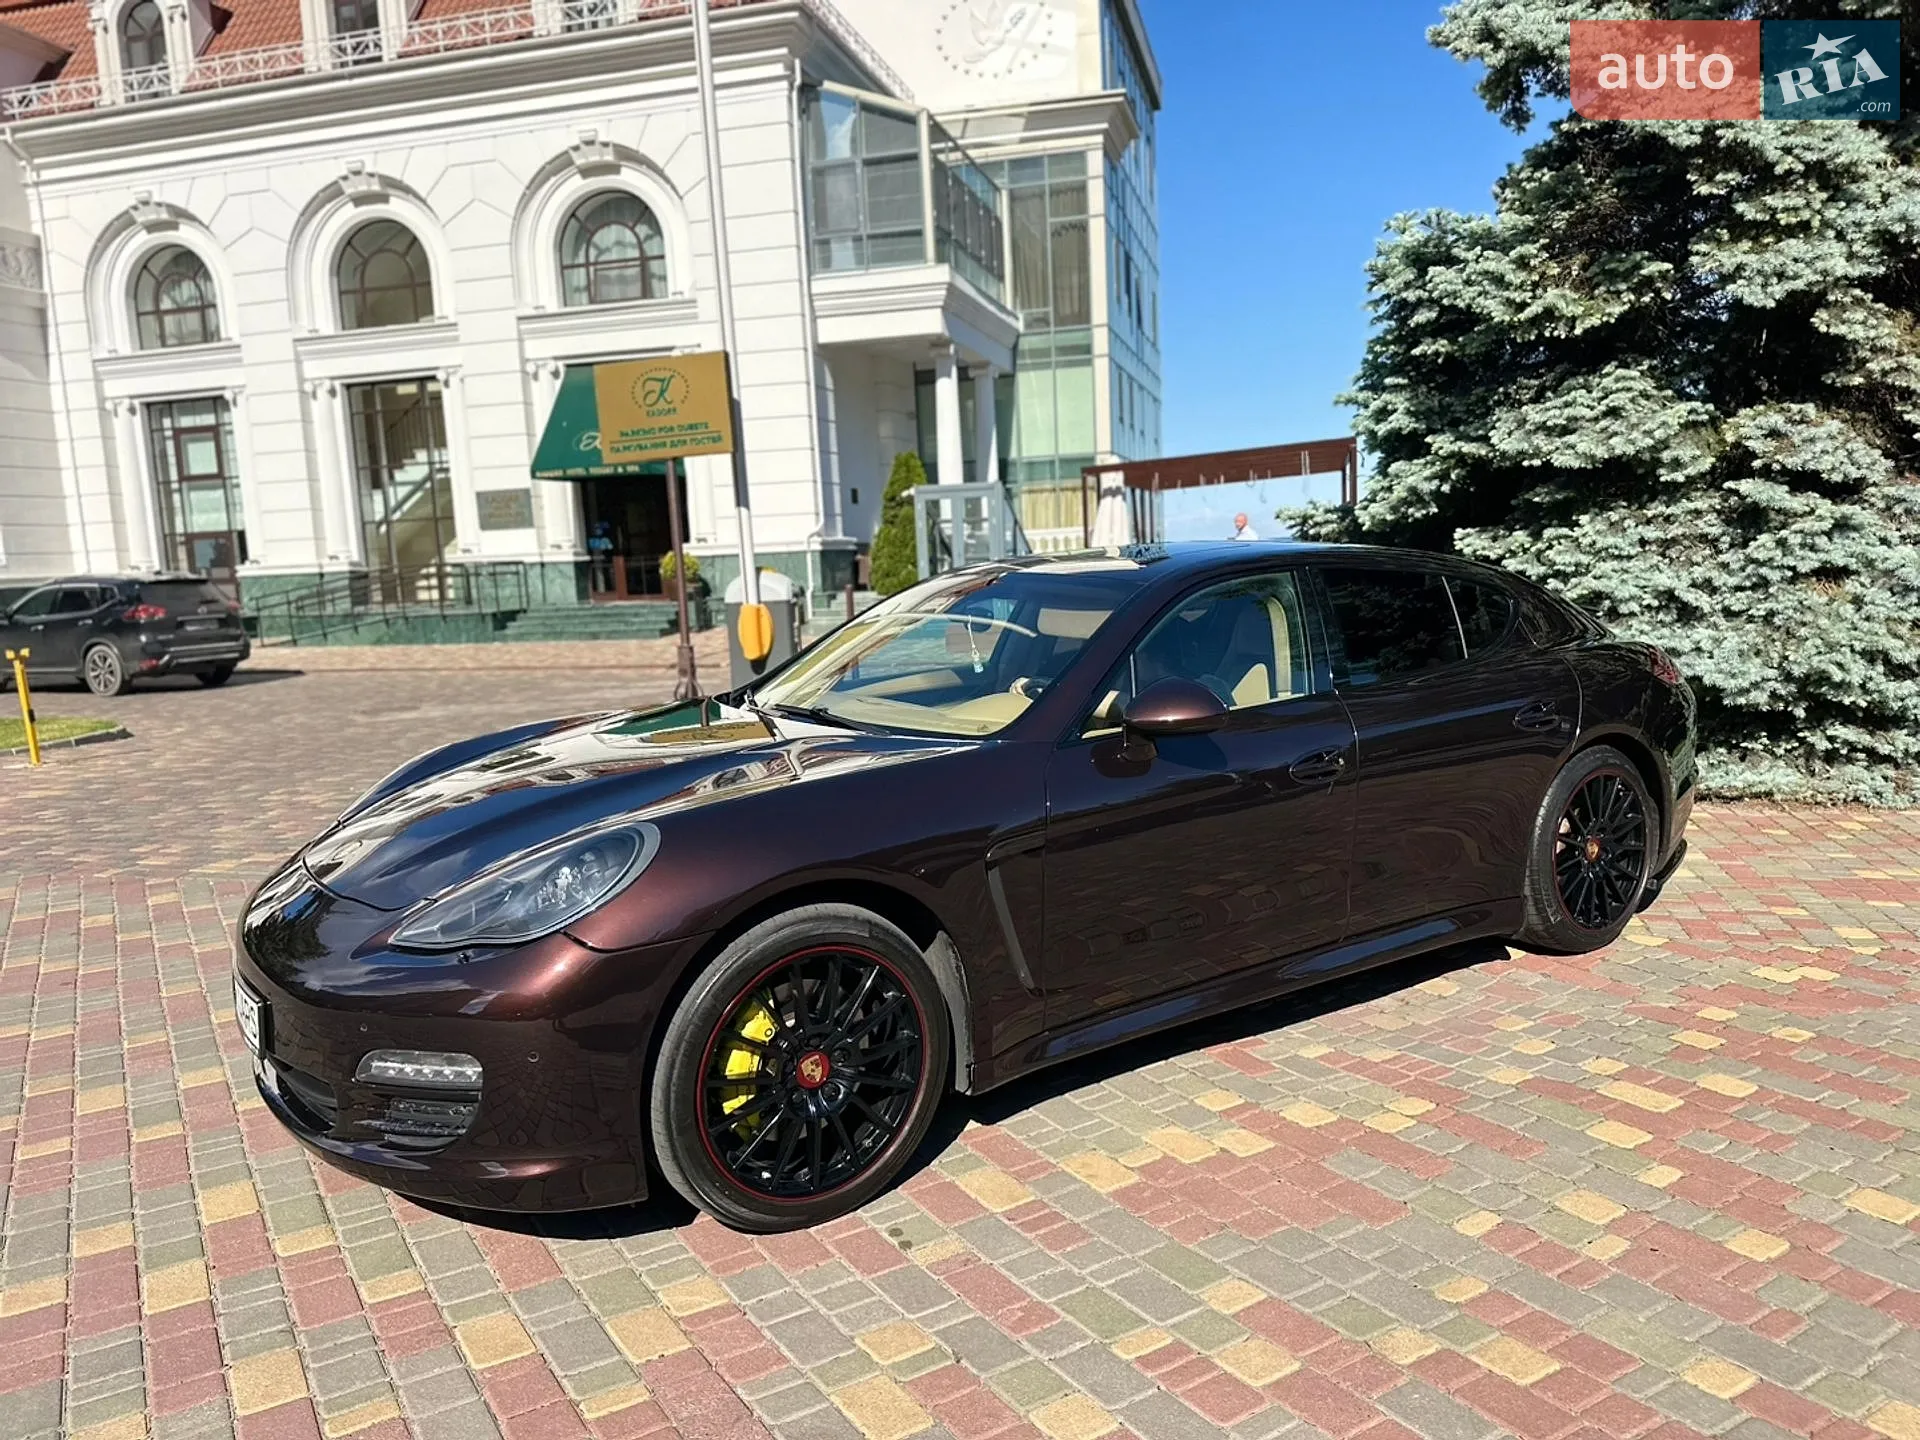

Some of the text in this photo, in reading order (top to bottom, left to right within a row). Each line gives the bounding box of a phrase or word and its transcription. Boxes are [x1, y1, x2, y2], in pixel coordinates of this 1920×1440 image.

[619, 422, 709, 438] PARKING FOR GUESTS
[669, 438, 688, 449] ДЛЯ
[689, 434, 723, 446] ГОСТЕЙ
